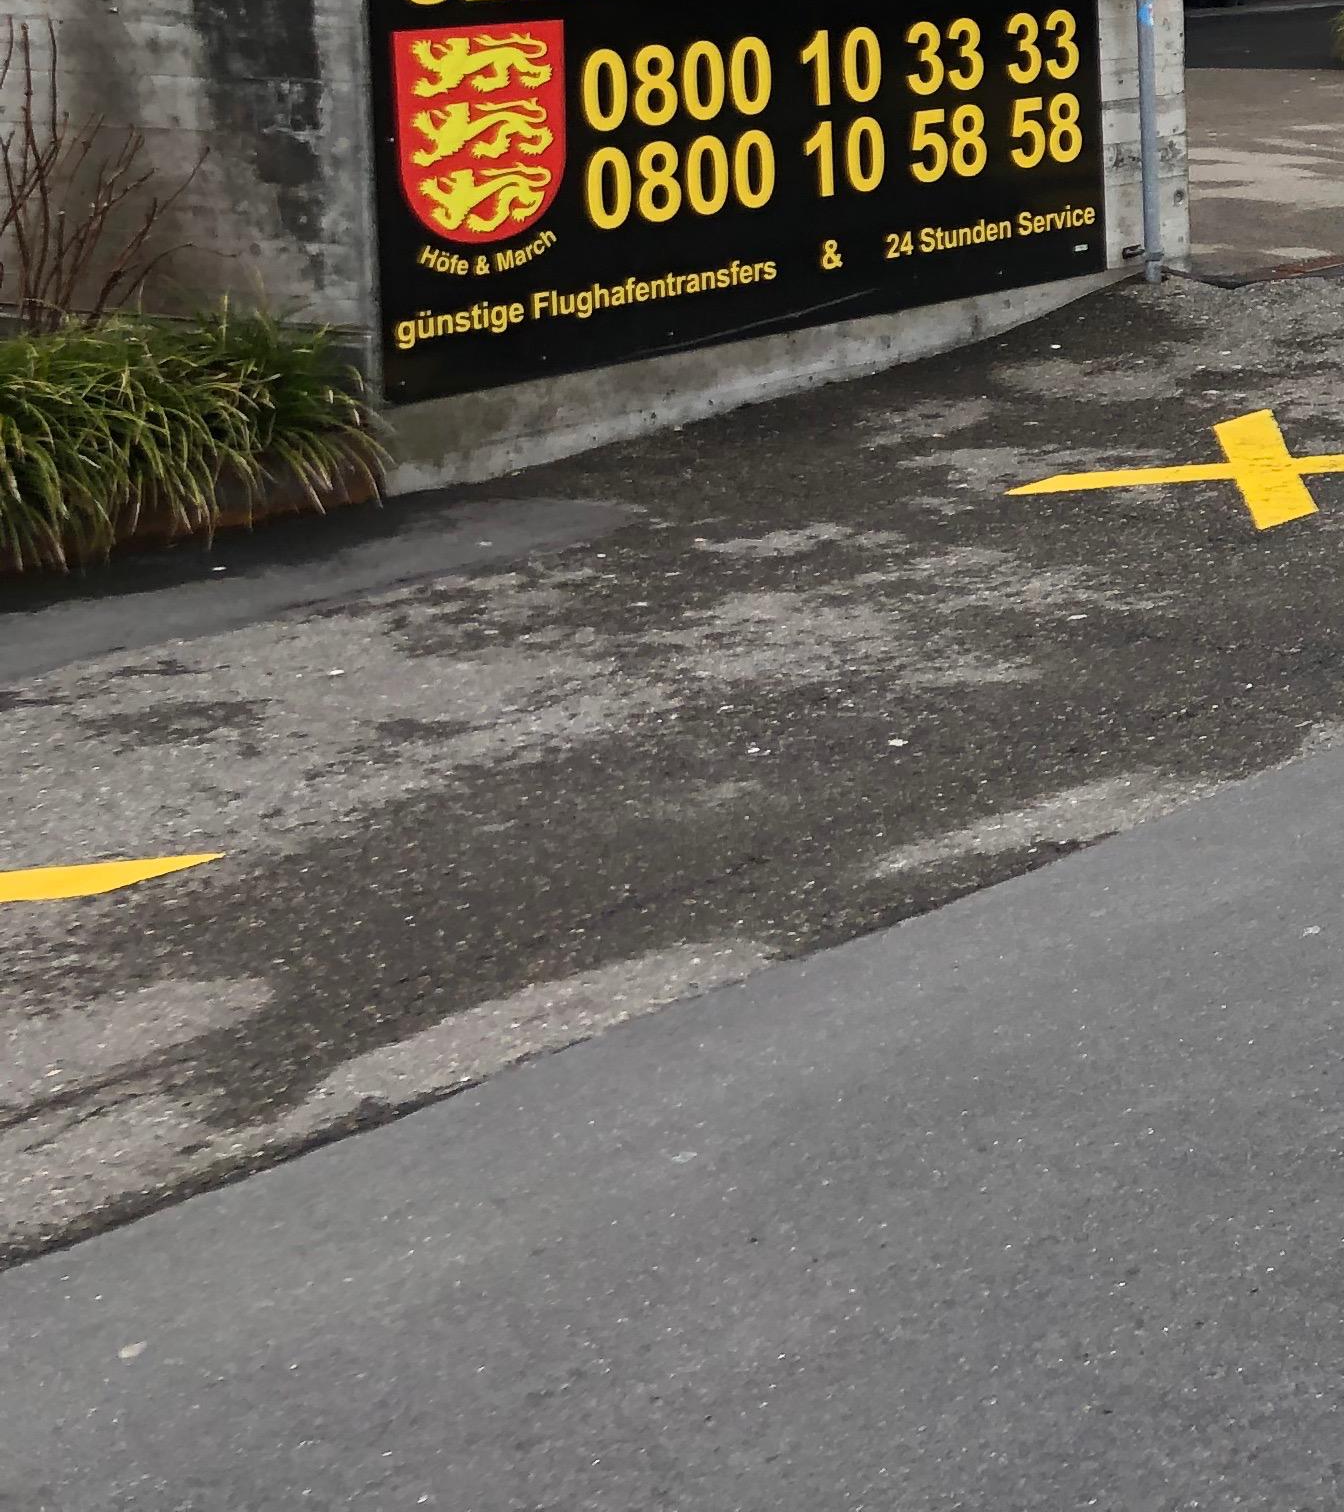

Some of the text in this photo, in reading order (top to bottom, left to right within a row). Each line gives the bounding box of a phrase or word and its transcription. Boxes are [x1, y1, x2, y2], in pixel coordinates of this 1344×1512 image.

[583, 9, 1080, 132] 0800 10 33 33
[586, 92, 1083, 230] 0800 10 58 58
[419, 228, 557, 276] Höfe & March
[821, 205, 1095, 270] & 24 Stunden Service
[396, 259, 778, 350] günstige Flughafentransfers
